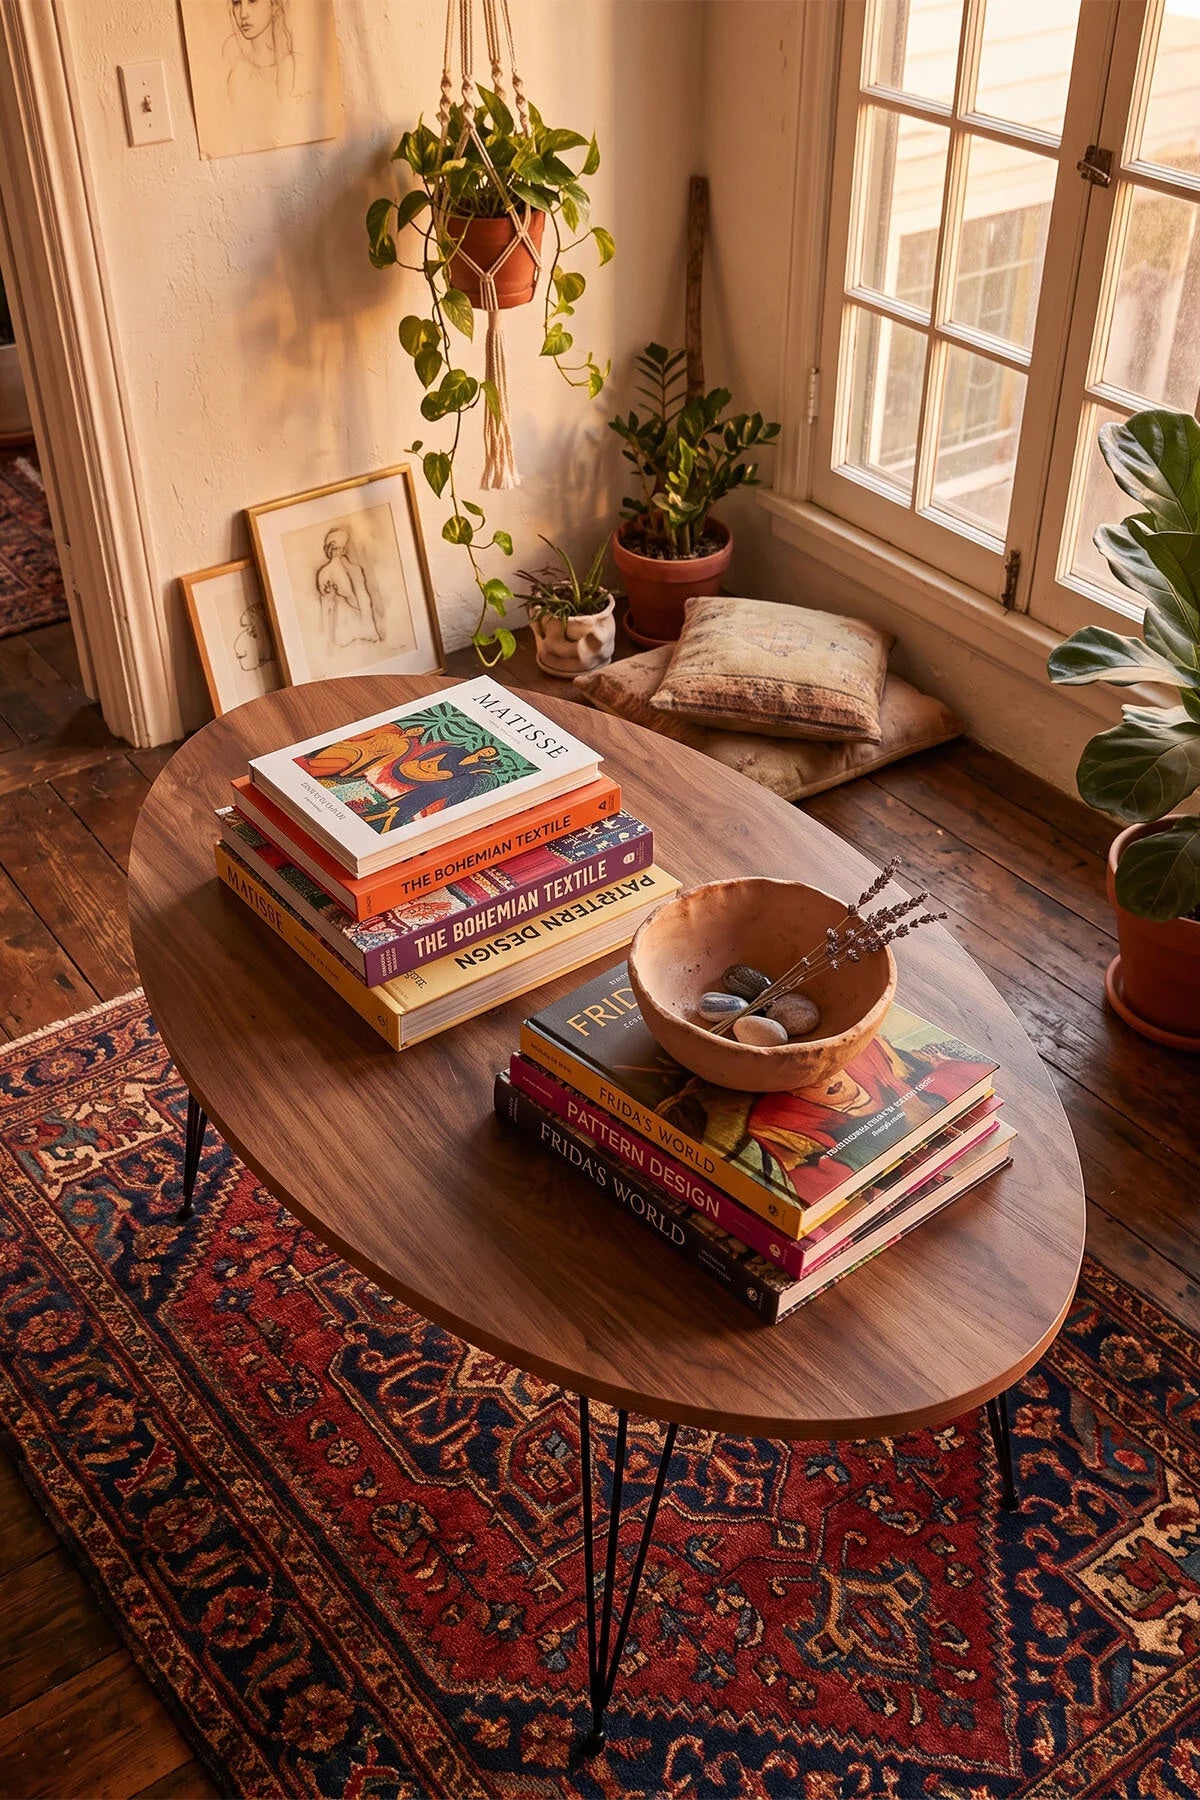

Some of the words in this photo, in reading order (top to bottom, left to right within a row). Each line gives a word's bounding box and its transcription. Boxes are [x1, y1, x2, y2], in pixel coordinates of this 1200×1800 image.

[472, 692, 569, 760] MATISSE
[401, 872, 432, 895] THE
[434, 839, 512, 880] BOHEMIAN
[515, 815, 572, 847] TEXTILE
[414, 932, 448, 958] THE
[452, 889, 539, 943] BOHEMIAN
[543, 859, 608, 903] TEXTILE
[453, 926, 541, 970] DESIGN
[566, 987, 639, 1037] FRID
[567, 1100, 645, 1166] PATTERN
[649, 1158, 721, 1219] DESIGN
[599, 1087, 653, 1133] FRIDA'S
[658, 1126, 716, 1175] WORLD
[540, 1122, 608, 1187] FRIDA'S
[612, 1176, 686, 1248] WORLD
